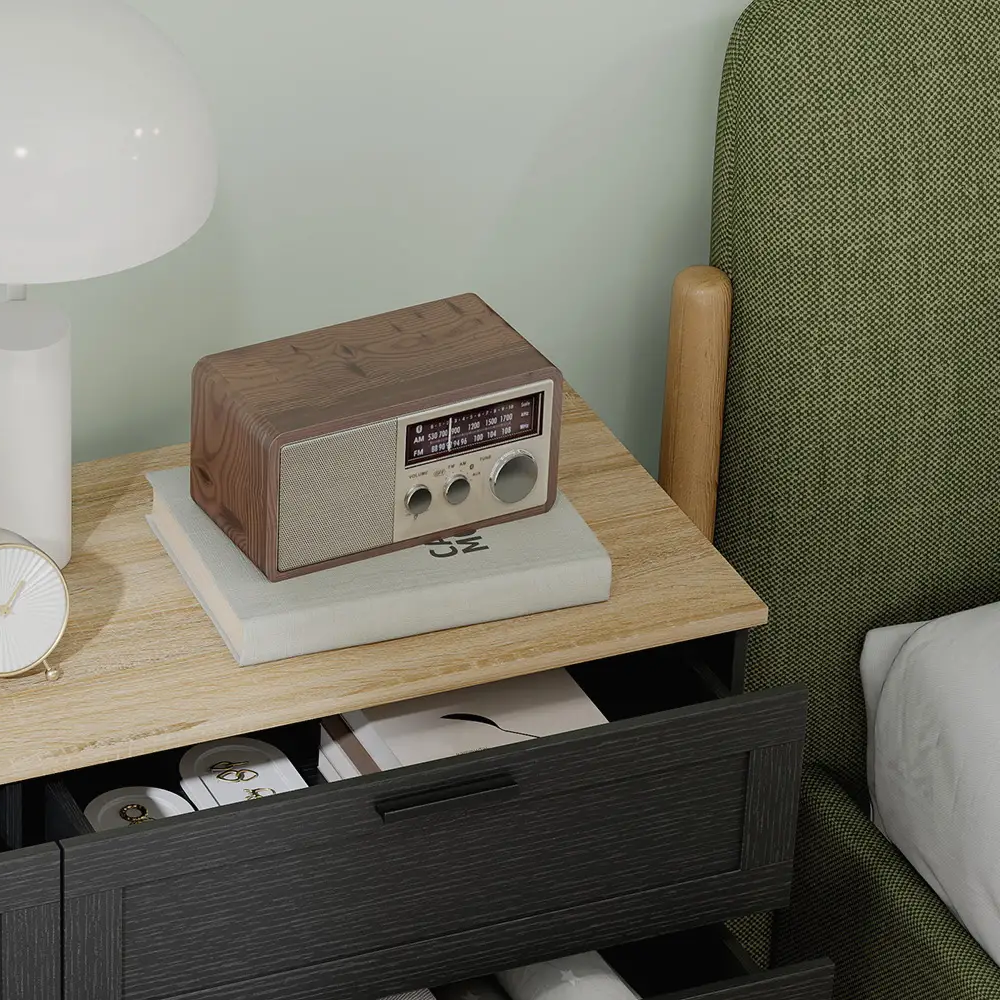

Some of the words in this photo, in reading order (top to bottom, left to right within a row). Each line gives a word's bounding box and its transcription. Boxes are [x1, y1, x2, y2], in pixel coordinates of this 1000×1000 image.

[413, 435, 425, 444] AM
[427, 431, 438, 441] 530
[439, 429, 449, 438] 700
[451, 426, 461, 435] 900
[468, 421, 481, 431] 1200
[485, 417, 498, 426] 1500
[500, 413, 513, 422] 1700
[413, 448, 424, 457] FM
[452, 439, 460, 447] 94
[460, 437, 468, 445] 96
[473, 433, 484, 442] 100
[487, 430, 497, 439] 104
[502, 426, 512, 435] 108
[408, 470, 428, 479] VOLUME
